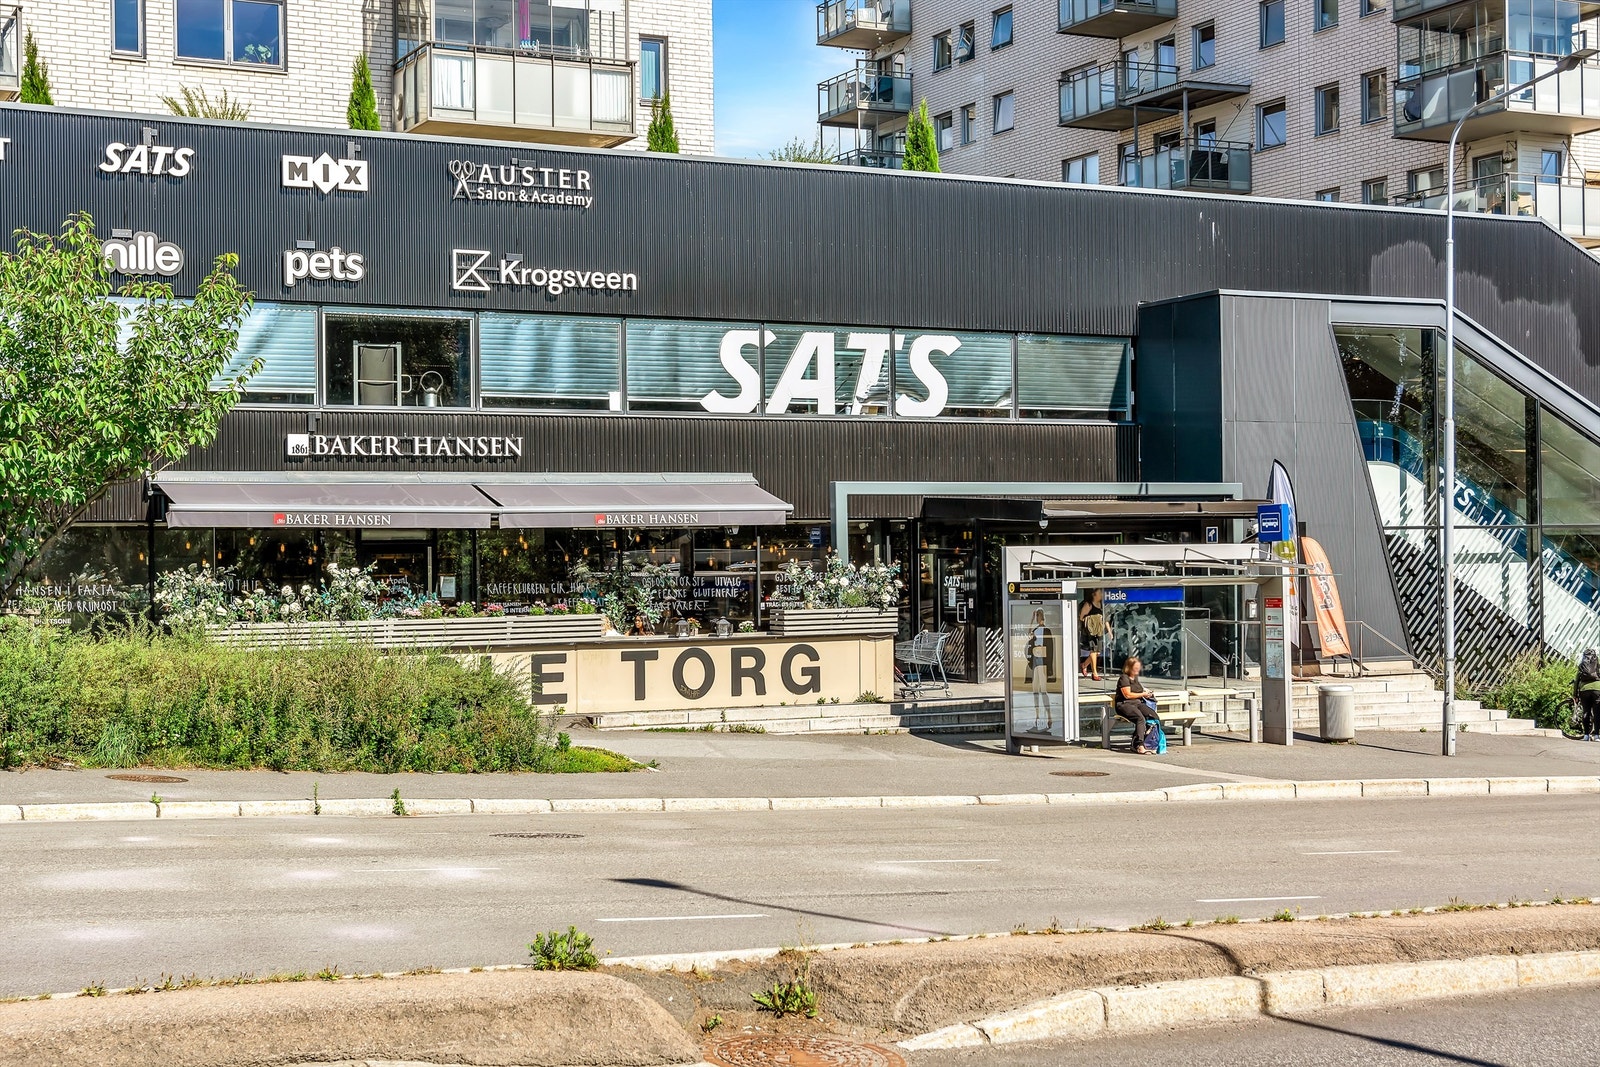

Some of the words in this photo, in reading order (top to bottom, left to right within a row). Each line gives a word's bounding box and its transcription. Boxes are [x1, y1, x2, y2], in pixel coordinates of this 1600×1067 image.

[99, 142, 195, 177] SATS
[286, 158, 364, 187] MIX
[478, 163, 591, 191] AUSTER
[477, 187, 517, 202] Salon
[519, 189, 529, 202] &
[531, 191, 593, 209] Academy
[104, 235, 180, 272] nille
[285, 248, 364, 287] pets
[500, 259, 637, 295] Krogsveen
[700, 329, 963, 417] SATS
[313, 434, 403, 457] BAKER
[412, 435, 524, 457] HANSEN
[286, 513, 331, 526] BAKER
[335, 513, 392, 526] HANSEN
[606, 514, 645, 525] BAKER
[649, 513, 699, 524] HANSEN
[944, 575, 961, 587] SATS
[1104, 590, 1127, 601] Hasle
[620, 644, 821, 701] TORG
